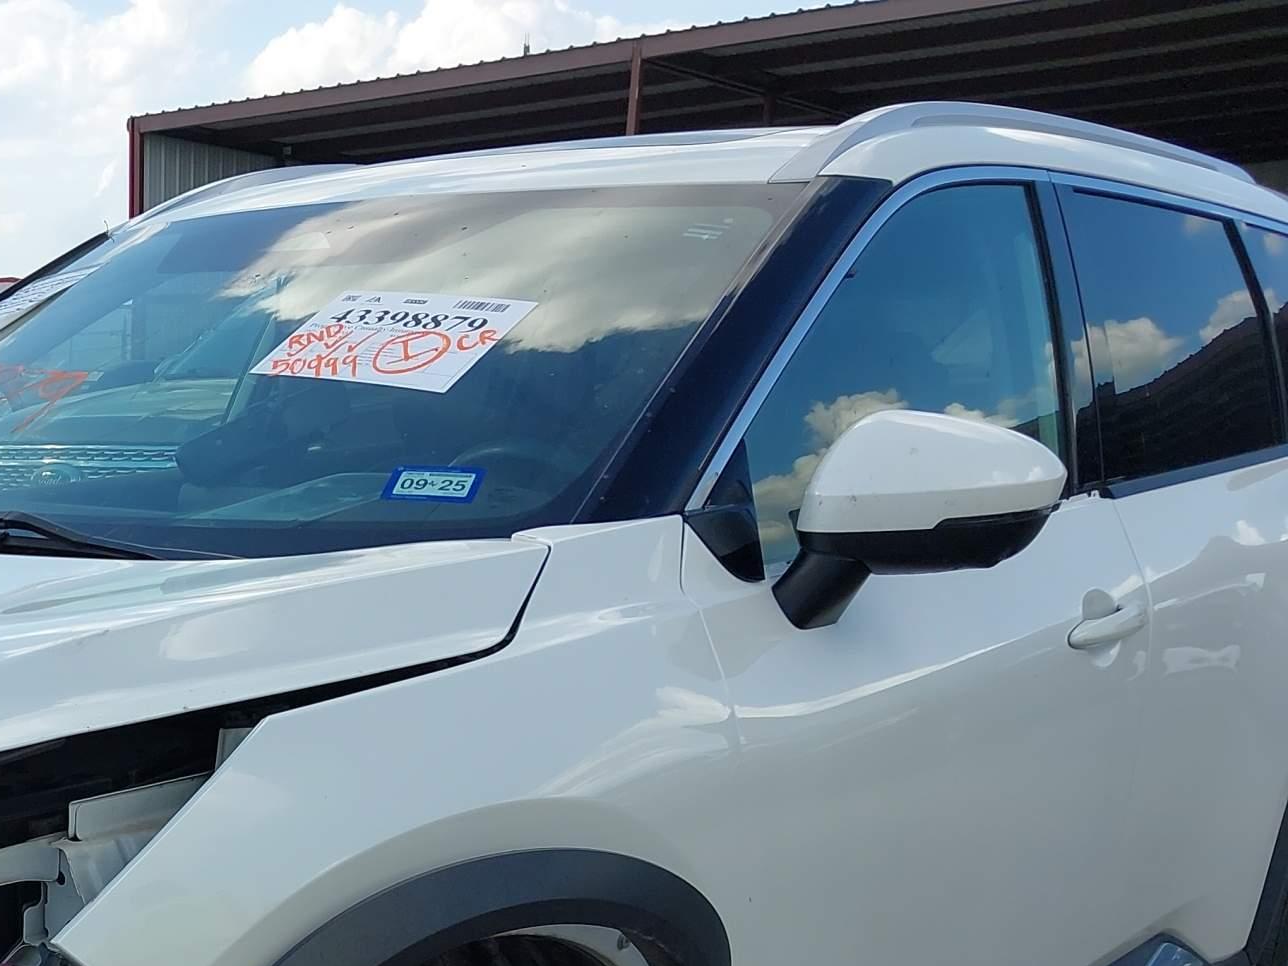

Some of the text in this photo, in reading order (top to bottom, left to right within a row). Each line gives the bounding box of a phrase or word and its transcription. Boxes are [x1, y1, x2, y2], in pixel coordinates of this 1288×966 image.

[329, 308, 489, 334] 43398879
[399, 478, 468, 492] 09 25
